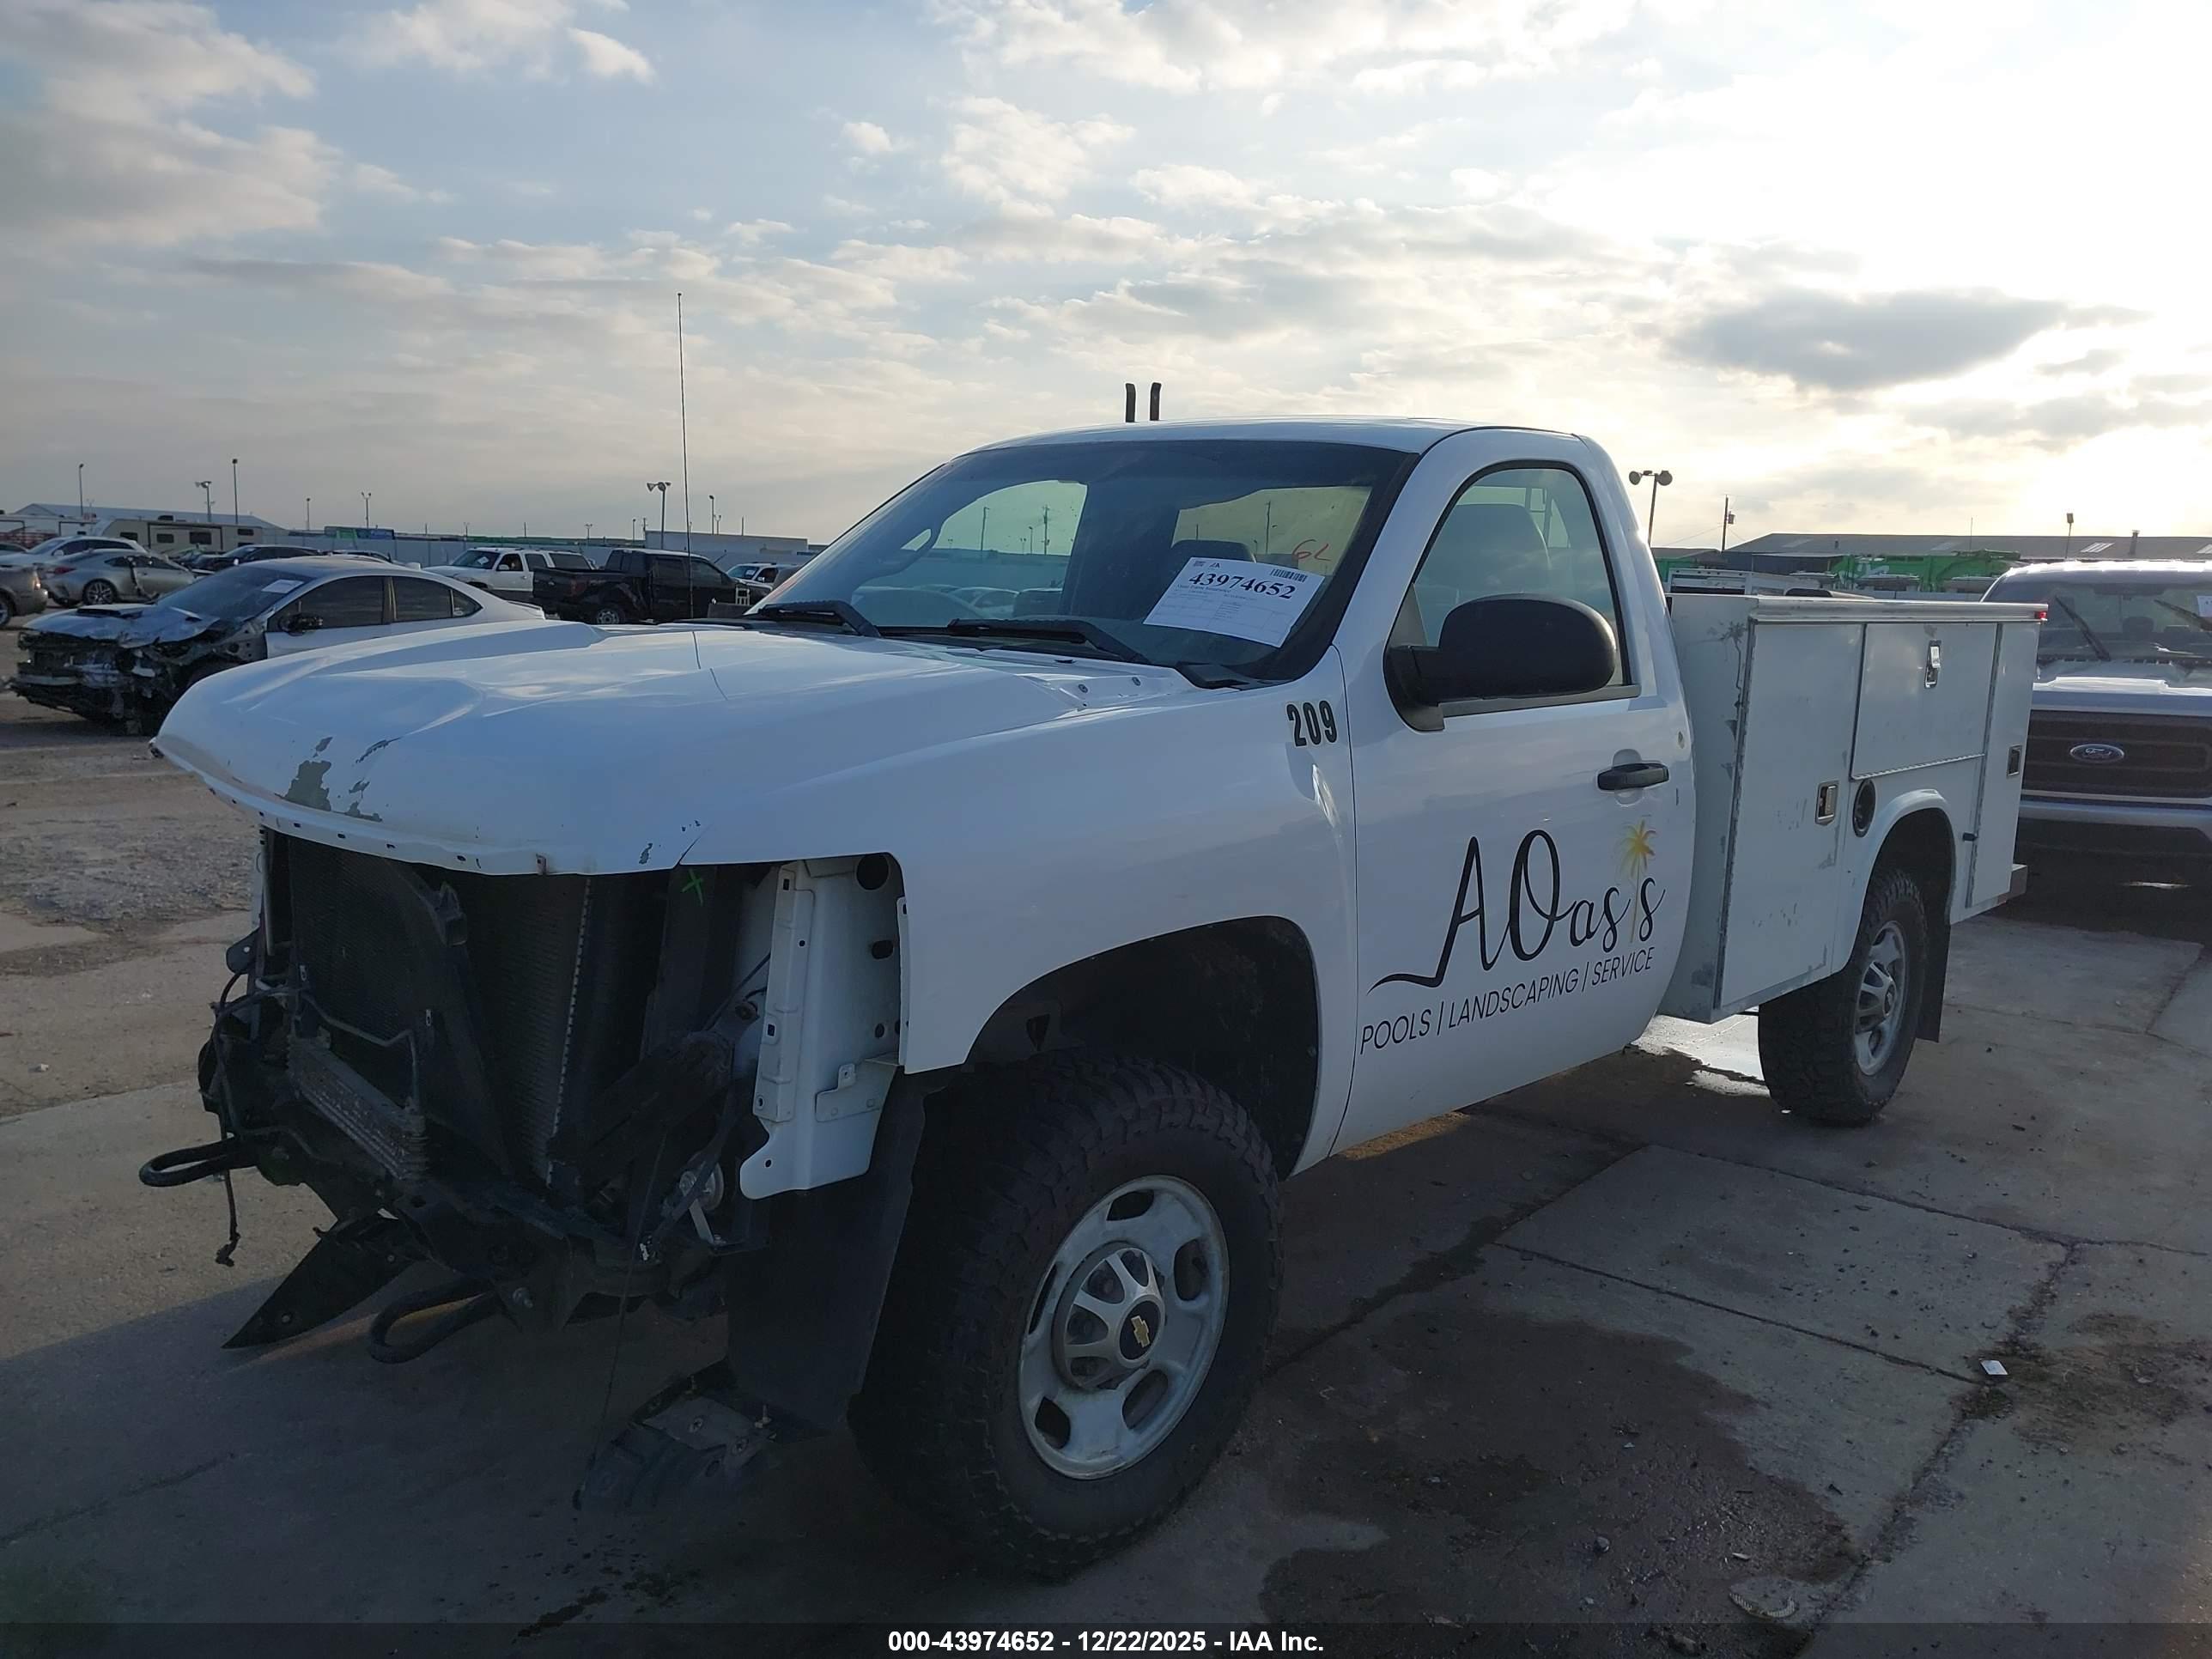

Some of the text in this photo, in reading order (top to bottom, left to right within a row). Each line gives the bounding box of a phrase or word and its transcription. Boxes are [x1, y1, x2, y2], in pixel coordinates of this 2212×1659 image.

[1188, 573, 1296, 599] 43974652
[1286, 700, 1337, 747] 209
[1360, 1009, 1431, 1054] POOLS
[1449, 968, 1579, 1030] LANDSCAPING
[1592, 946, 1656, 986] SERVICE
